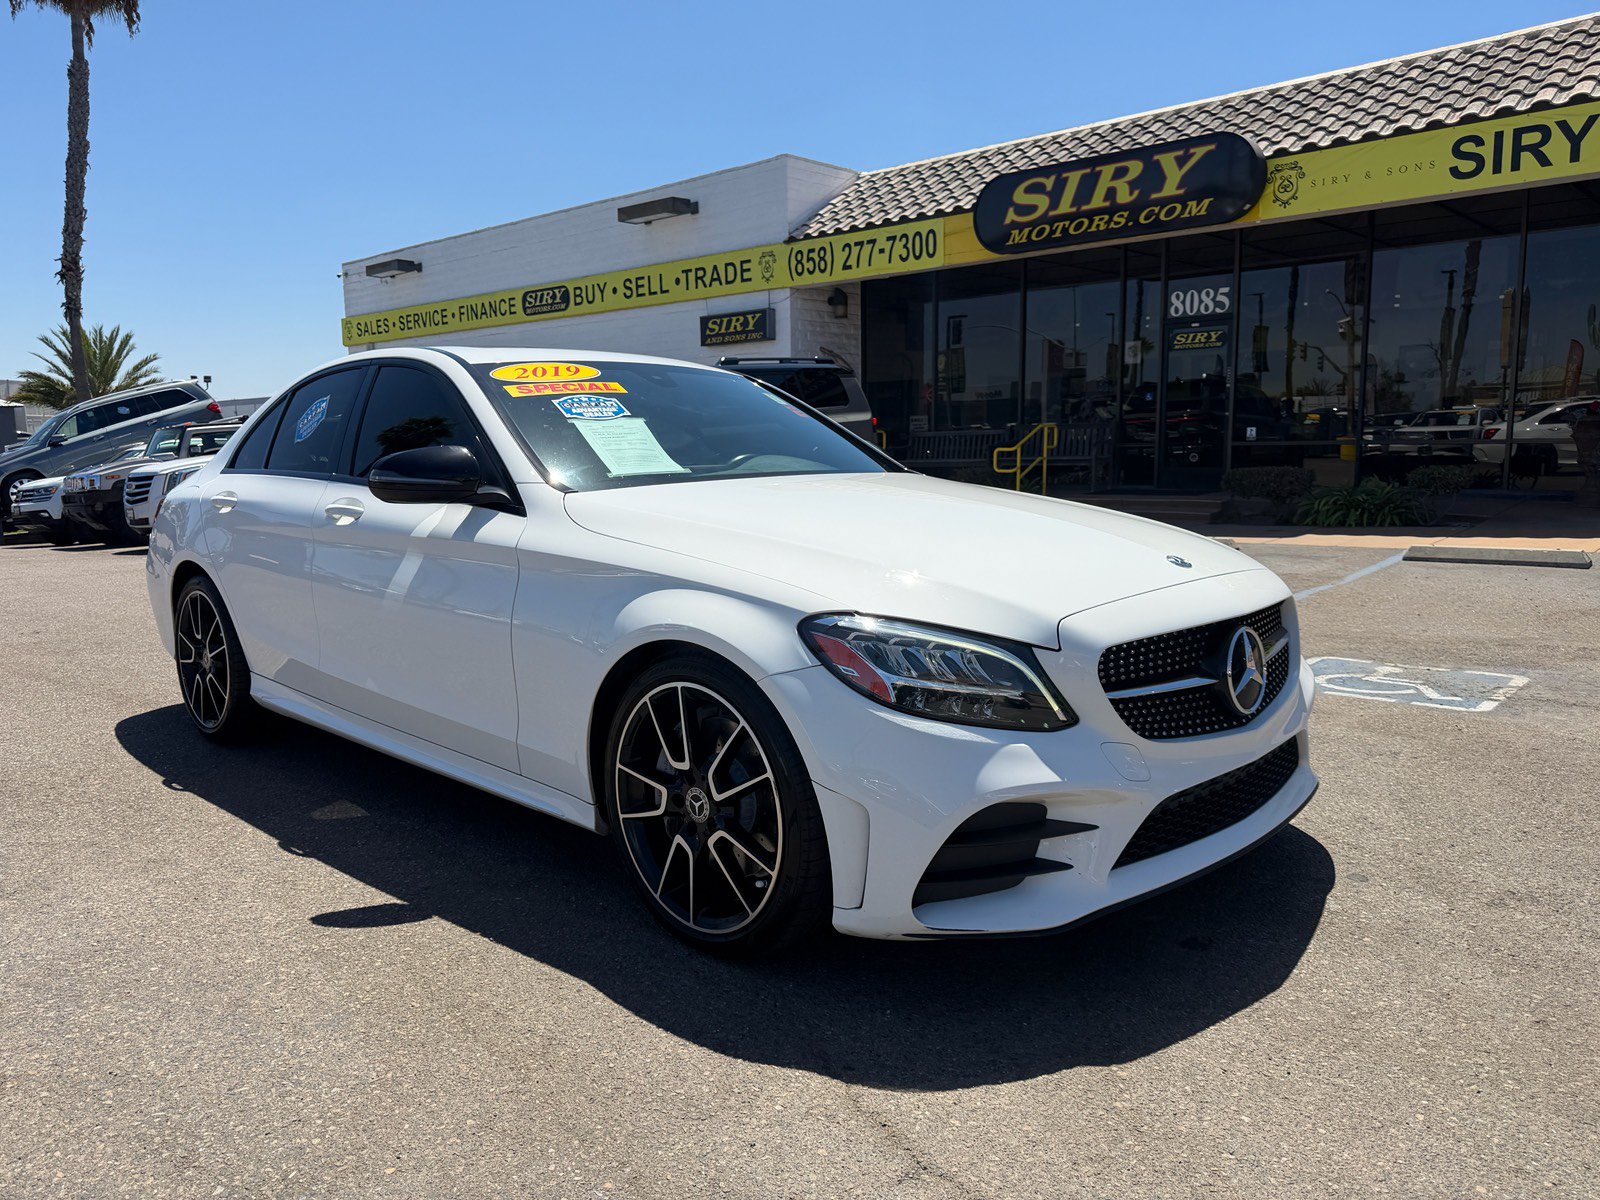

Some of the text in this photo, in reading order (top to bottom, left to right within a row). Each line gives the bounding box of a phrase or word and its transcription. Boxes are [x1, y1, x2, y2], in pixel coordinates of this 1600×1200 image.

[1448, 113, 1600, 180] SIRY
[1003, 142, 1218, 225] SIRY
[1310, 160, 1436, 188] SIRY & SONS
[1005, 197, 1214, 245] MOTORS.COM
[788, 228, 937, 282] (858) 277-7300
[526, 287, 567, 307] SIRY
[573, 259, 753, 307] BUY SELL TRADE
[1169, 286, 1231, 317] 8085
[356, 297, 517, 337] SALES SERVICE FINANCE
[705, 313, 762, 336] SIRY
[705, 331, 764, 345] AND SONS INC
[1173, 330, 1224, 345] SIRY
[514, 365, 581, 380] 2019
[516, 382, 620, 395] SPECIAL
